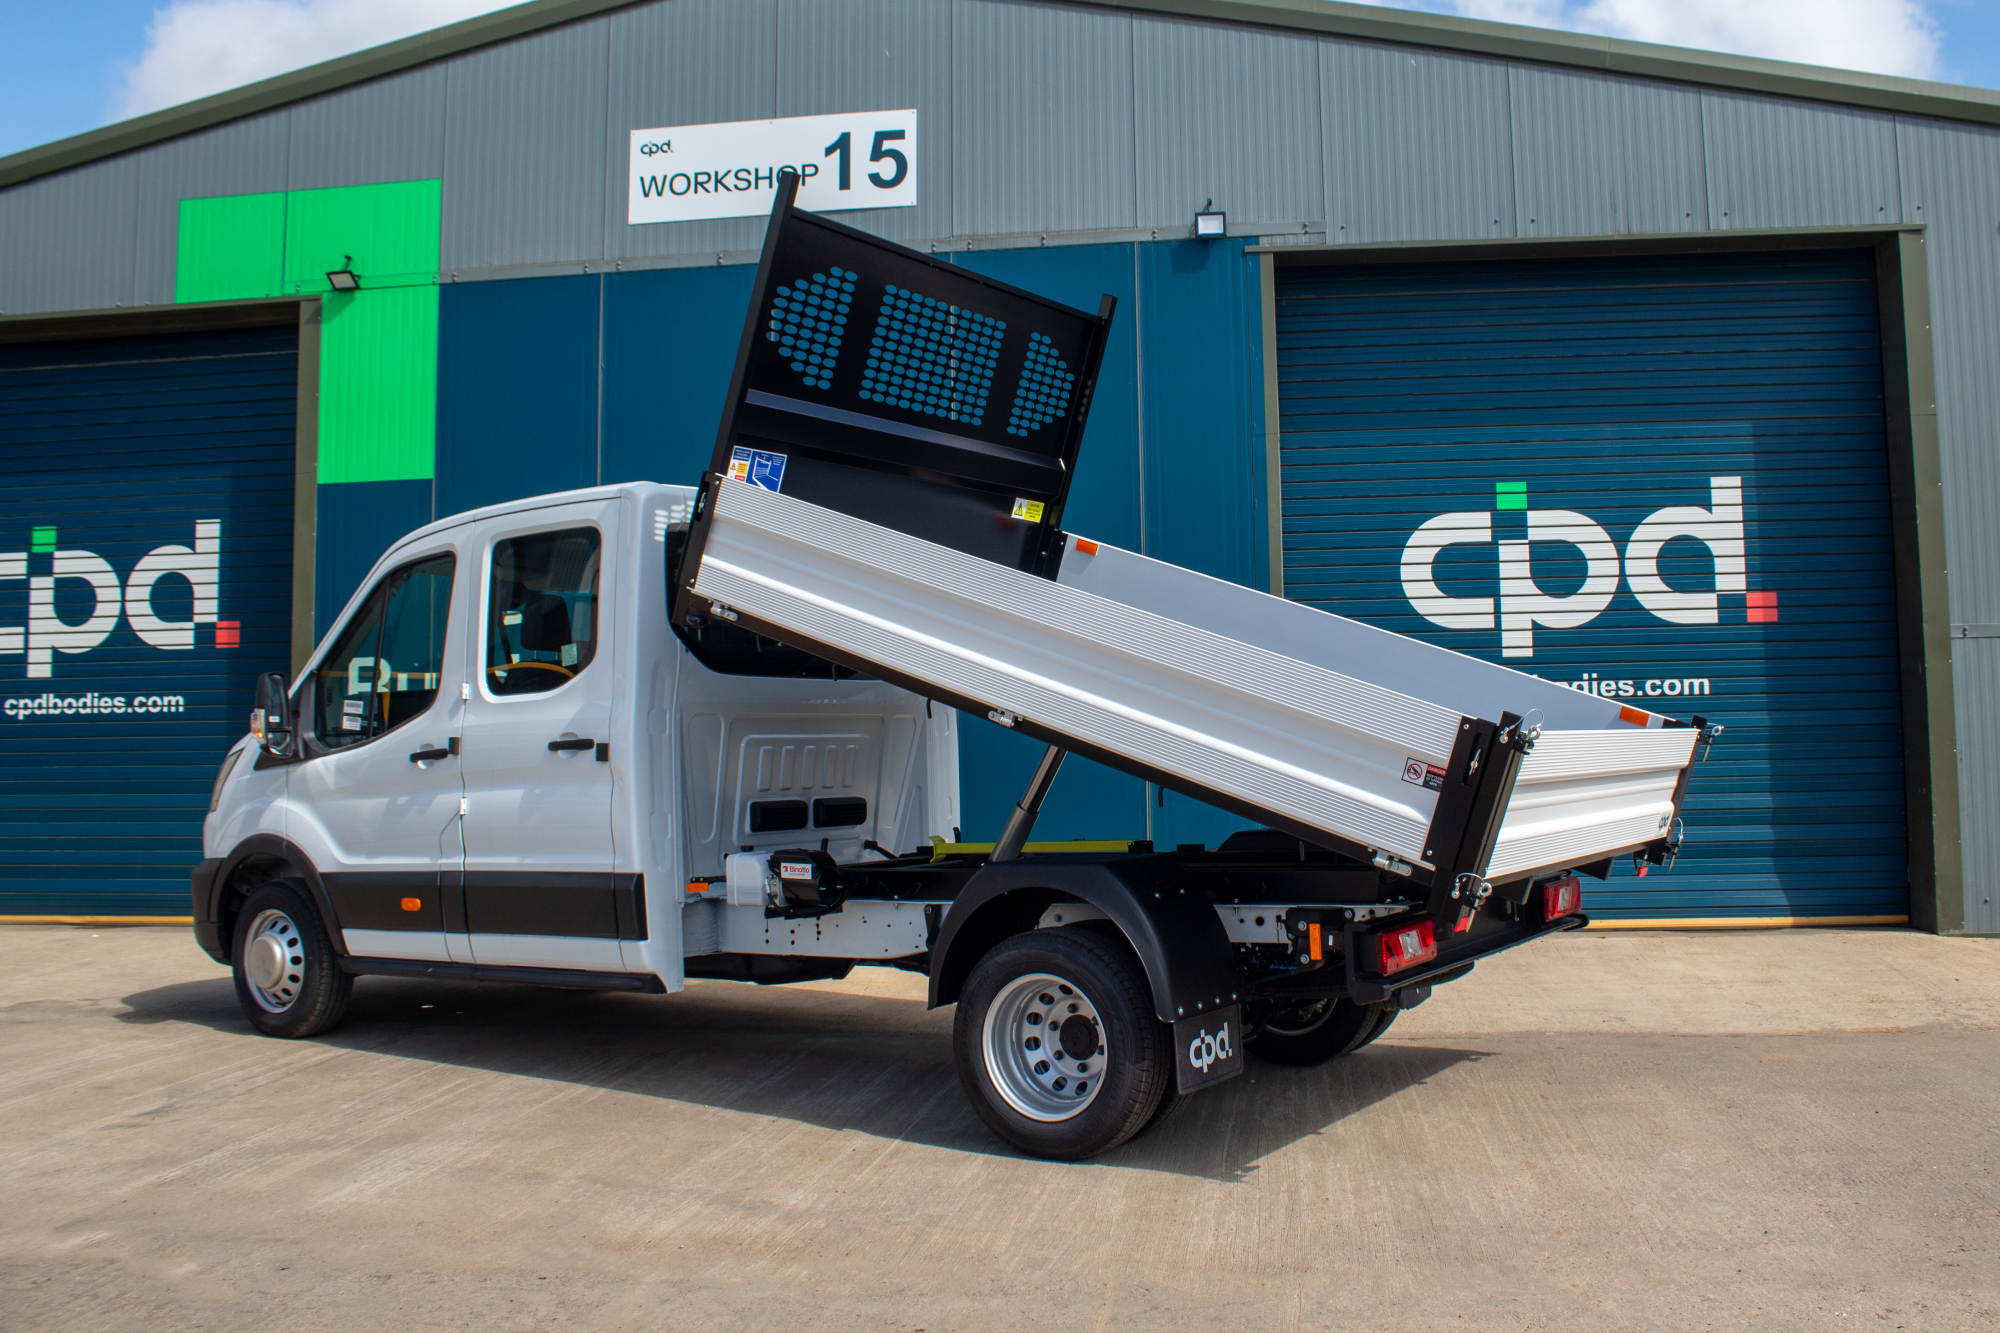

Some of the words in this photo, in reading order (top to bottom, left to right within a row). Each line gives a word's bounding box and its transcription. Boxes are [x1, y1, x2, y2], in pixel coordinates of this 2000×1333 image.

[824, 129, 908, 191] 15
[4, 693, 185, 720] cpdbodies.com
[789, 865, 810, 873] Binotto
